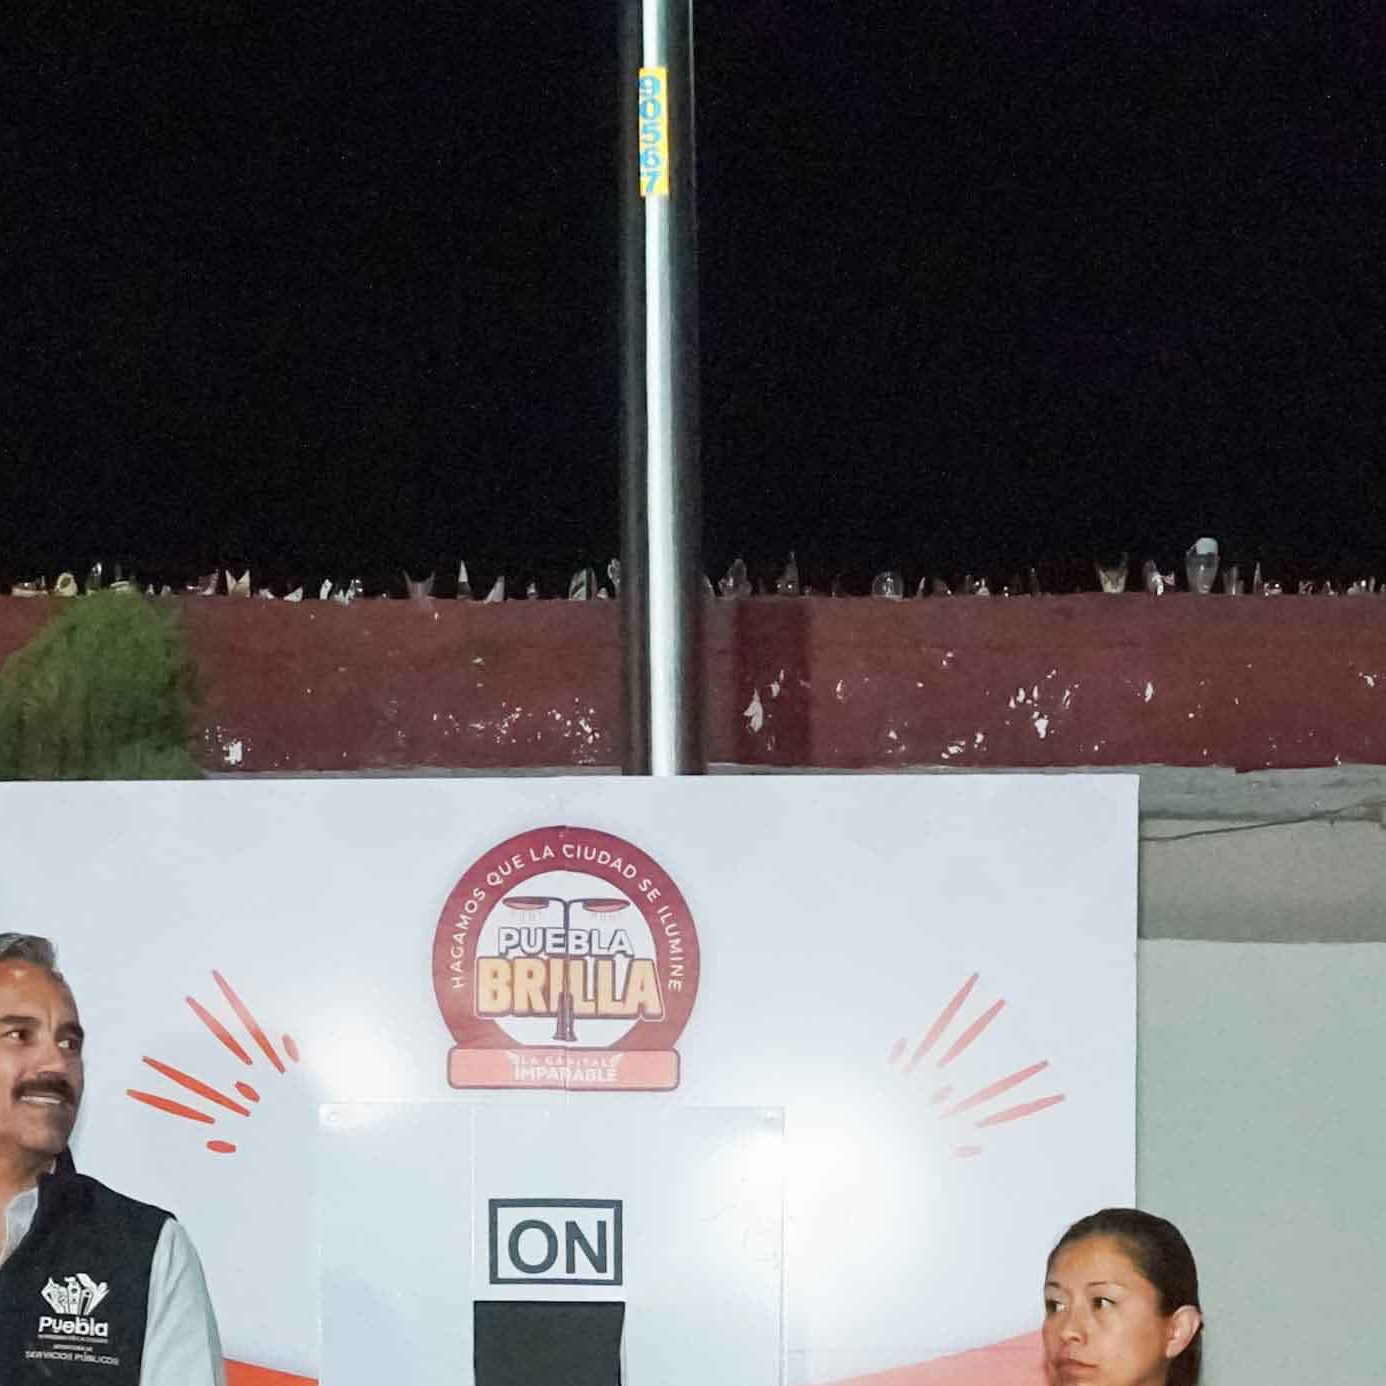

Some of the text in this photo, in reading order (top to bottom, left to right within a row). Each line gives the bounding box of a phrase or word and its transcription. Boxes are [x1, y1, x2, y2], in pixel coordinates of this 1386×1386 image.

[451, 843, 686, 992] HAGAMOS QUE LA CIUDAD SE ILUMINE
[498, 927, 635, 959] PUEBLA
[476, 956, 664, 1021] BRILLA
[515, 1066, 617, 1081] IMPARABLE
[507, 1219, 607, 1275] ON
[38, 1316, 109, 1337] Puebla
